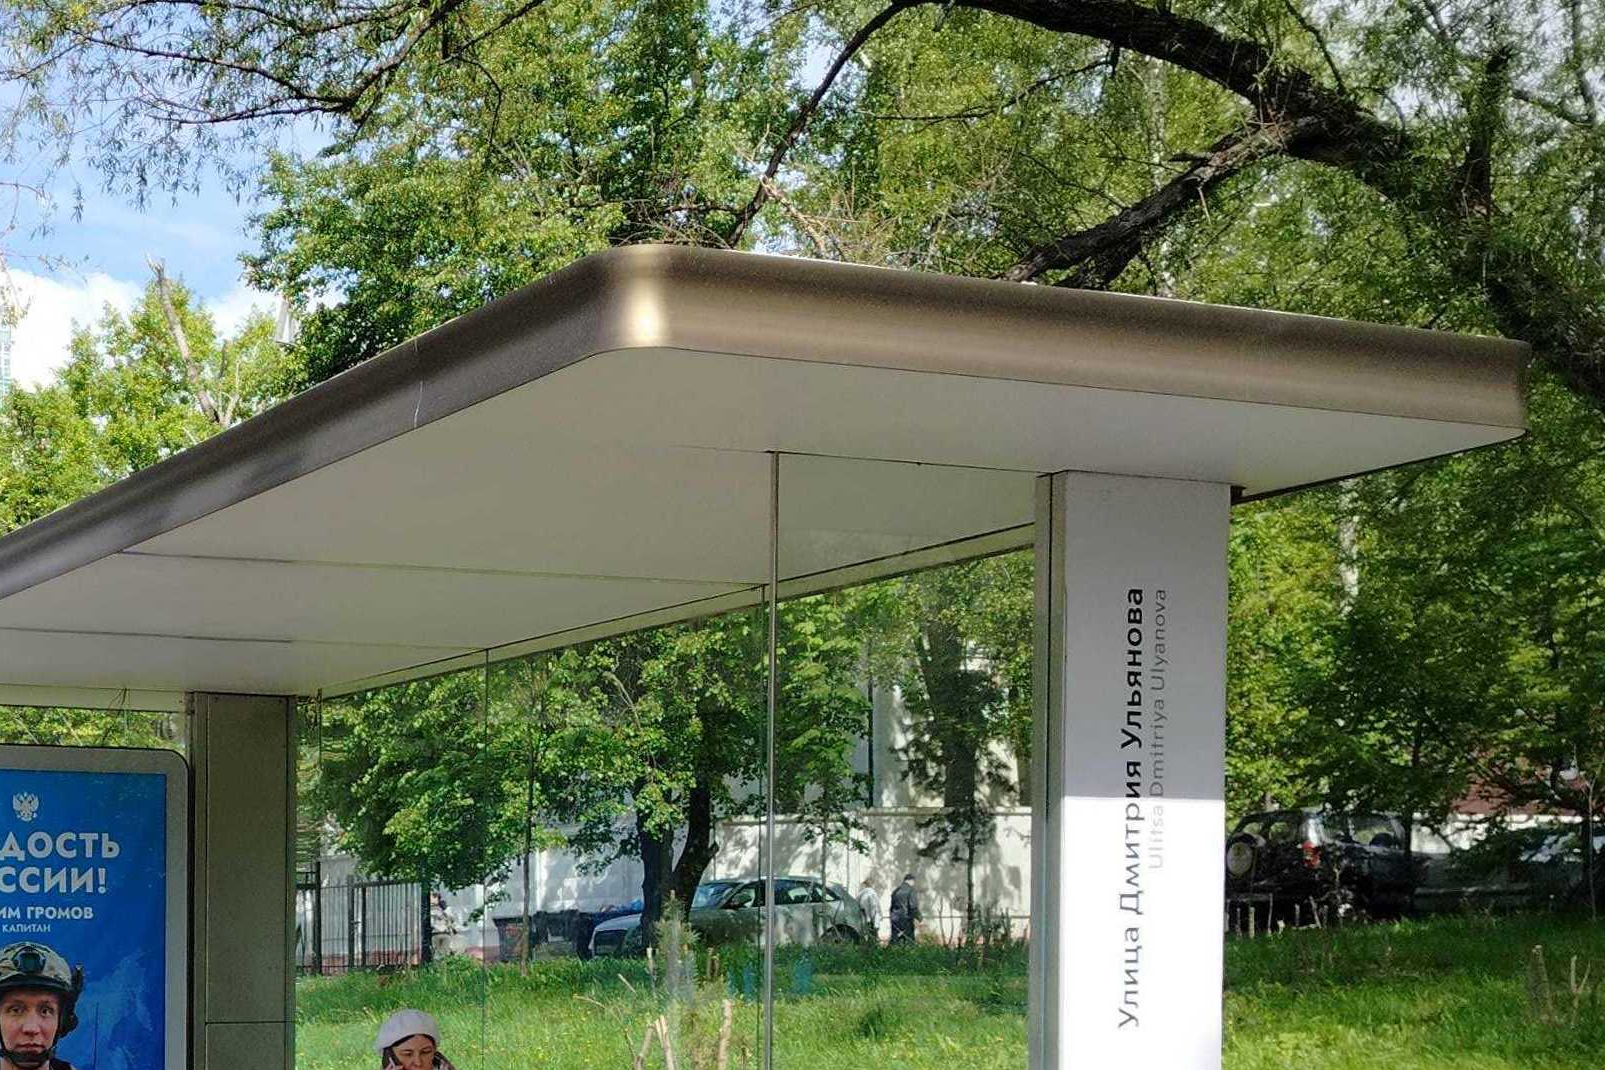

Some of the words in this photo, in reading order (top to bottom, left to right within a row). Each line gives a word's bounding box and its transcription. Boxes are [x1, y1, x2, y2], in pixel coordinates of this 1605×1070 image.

[1120, 588, 1144, 750] Ульянова
[1151, 589, 1168, 691] Ulyanova
[1149, 698, 1167, 797] Dmitriya
[1119, 760, 1145, 915] Дмитрия
[1149, 806, 1165, 870] Ulitsa
[2, 923, 51, 934] КАПИТАН
[26, 905, 94, 921] ГРОМОВ
[1118, 926, 1140, 1028] Улица
